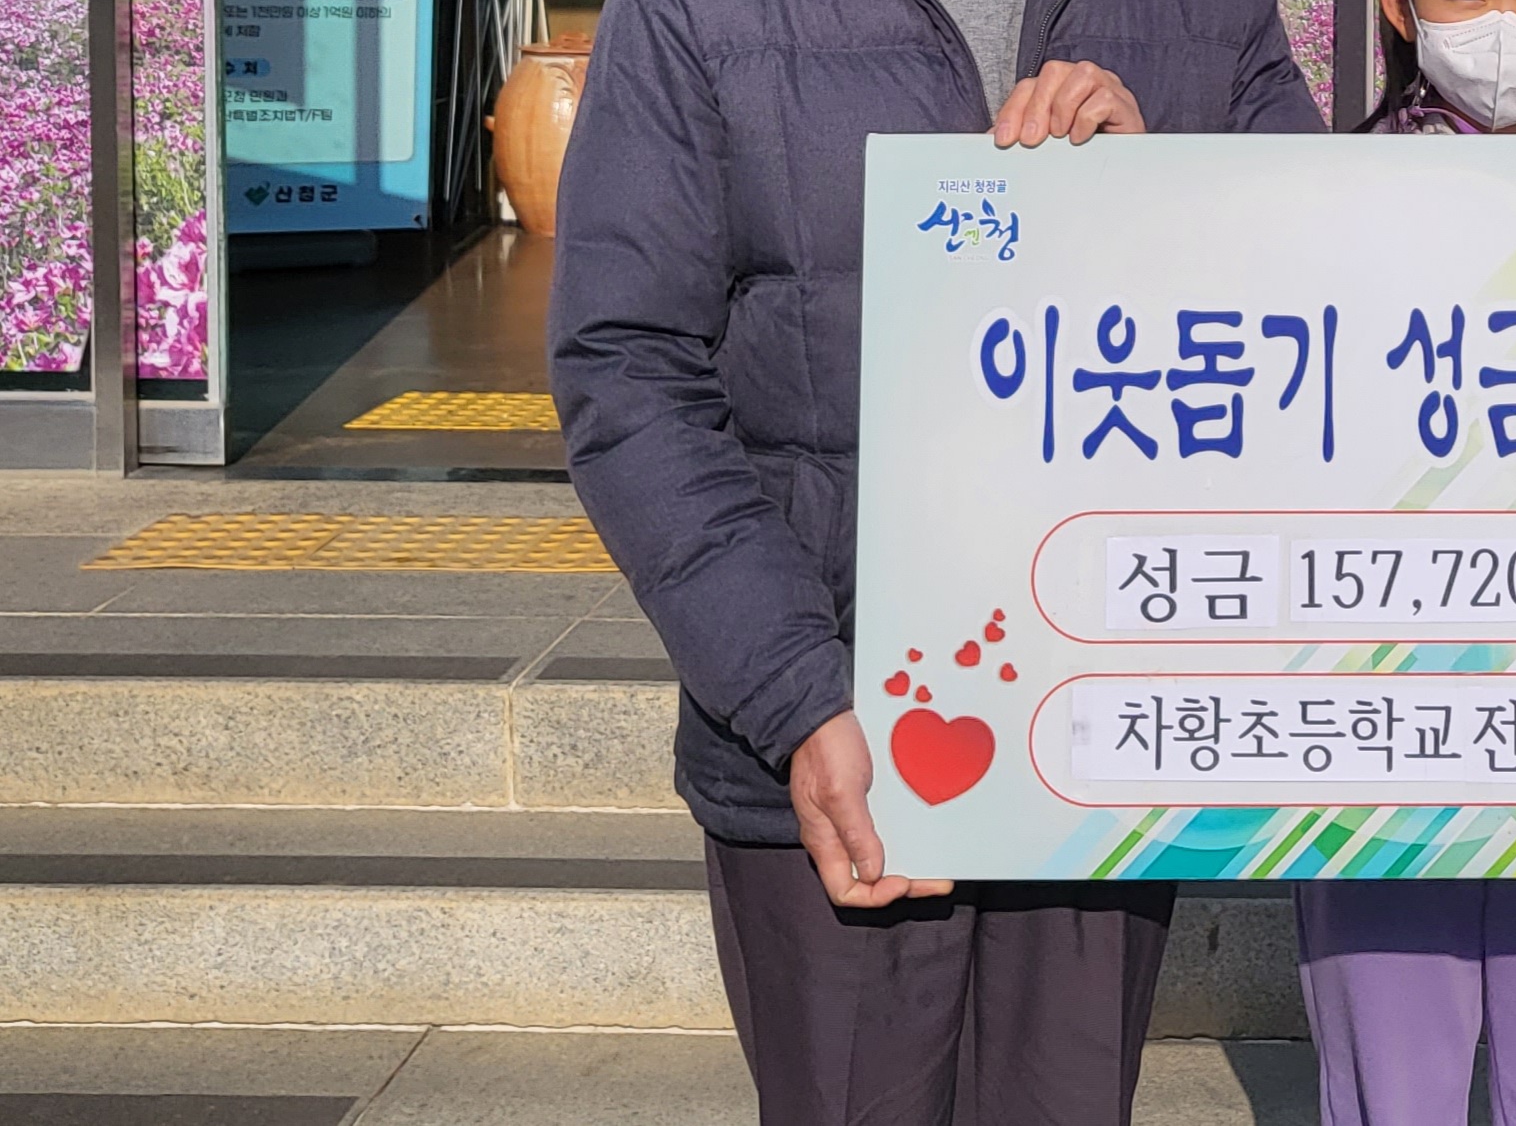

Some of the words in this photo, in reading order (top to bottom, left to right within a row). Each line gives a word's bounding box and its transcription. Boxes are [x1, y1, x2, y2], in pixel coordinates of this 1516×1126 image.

[297, 6, 321, 18] 이상
[938, 180, 970, 193] 지리산
[974, 179, 1007, 193] 청정골
[980, 304, 1338, 463] 이웃돕기
[1118, 546, 1263, 622] 성금
[1115, 695, 1462, 773] 차황초등학교
